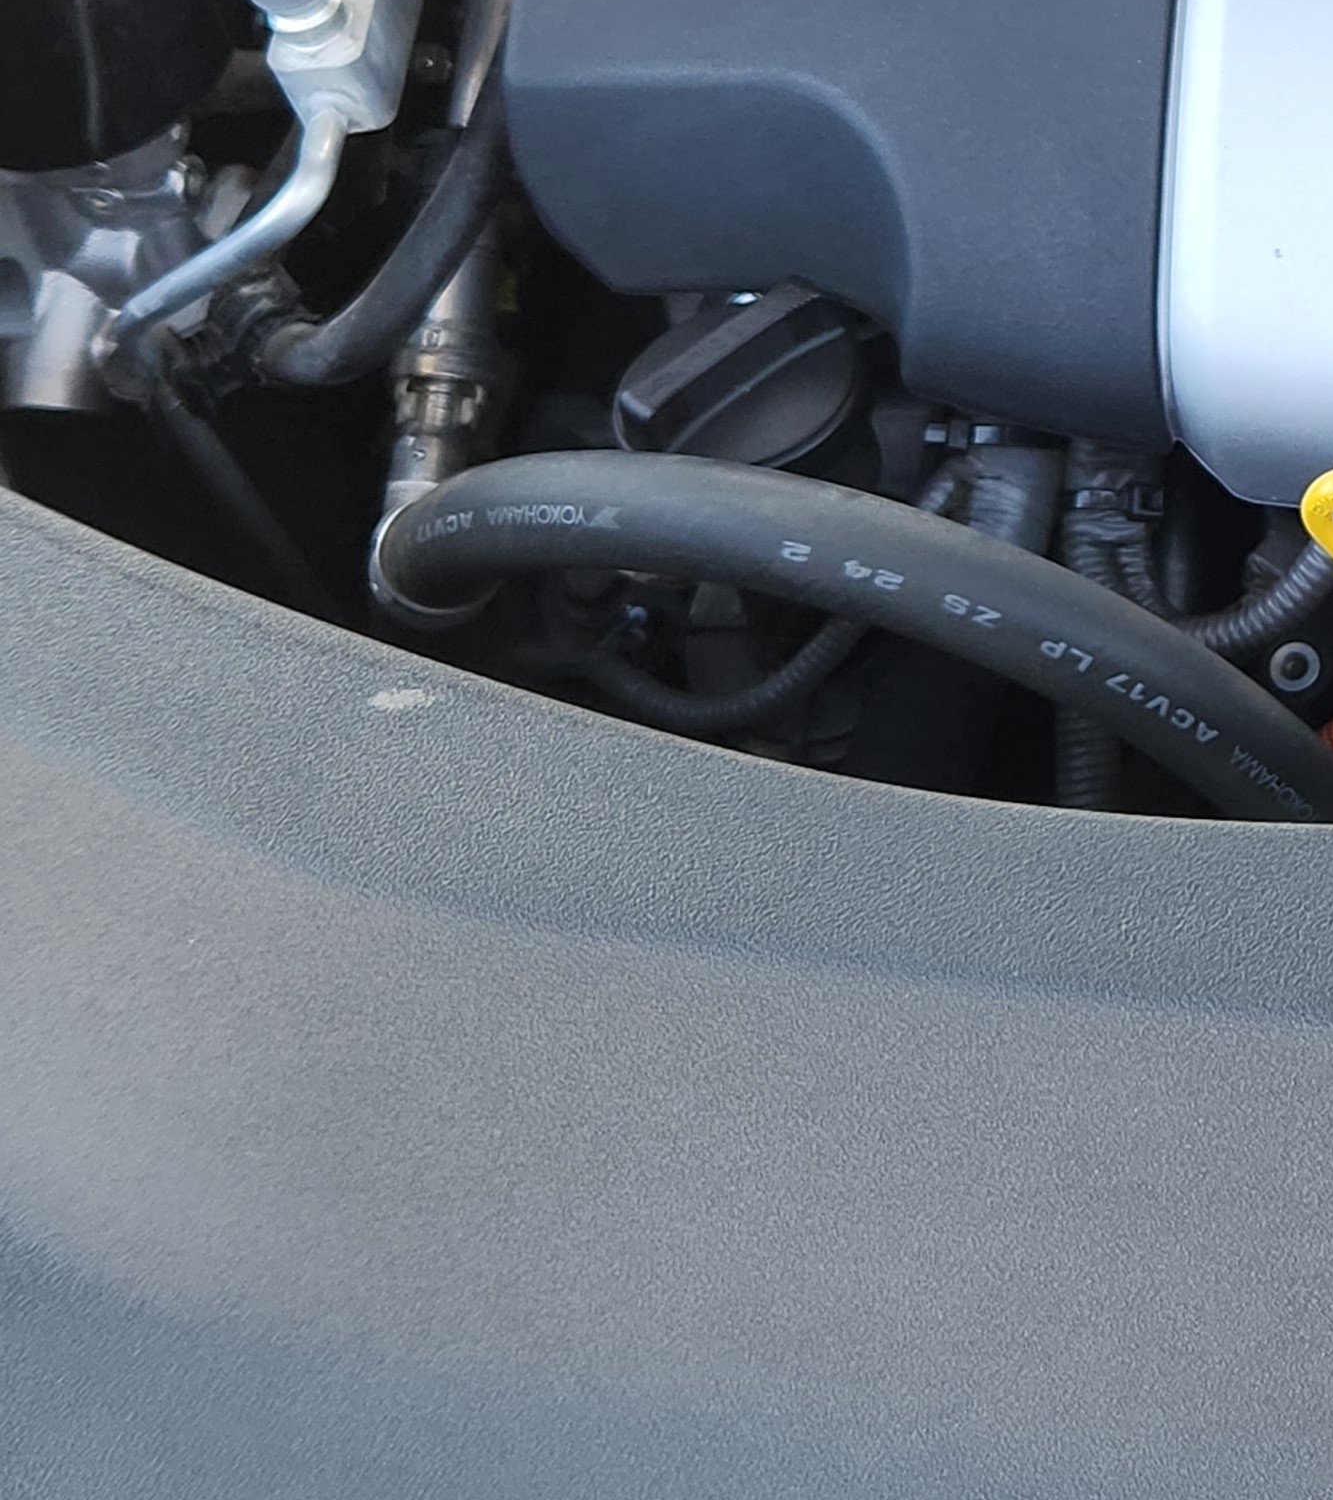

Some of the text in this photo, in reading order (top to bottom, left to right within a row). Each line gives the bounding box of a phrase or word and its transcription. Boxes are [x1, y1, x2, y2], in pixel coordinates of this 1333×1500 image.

[485, 504, 591, 527] YOKOHAMA
[779, 540, 812, 563] 2
[842, 558, 907, 591] 24
[1039, 638, 1094, 675] LP
[1106, 671, 1220, 744] ACV17
